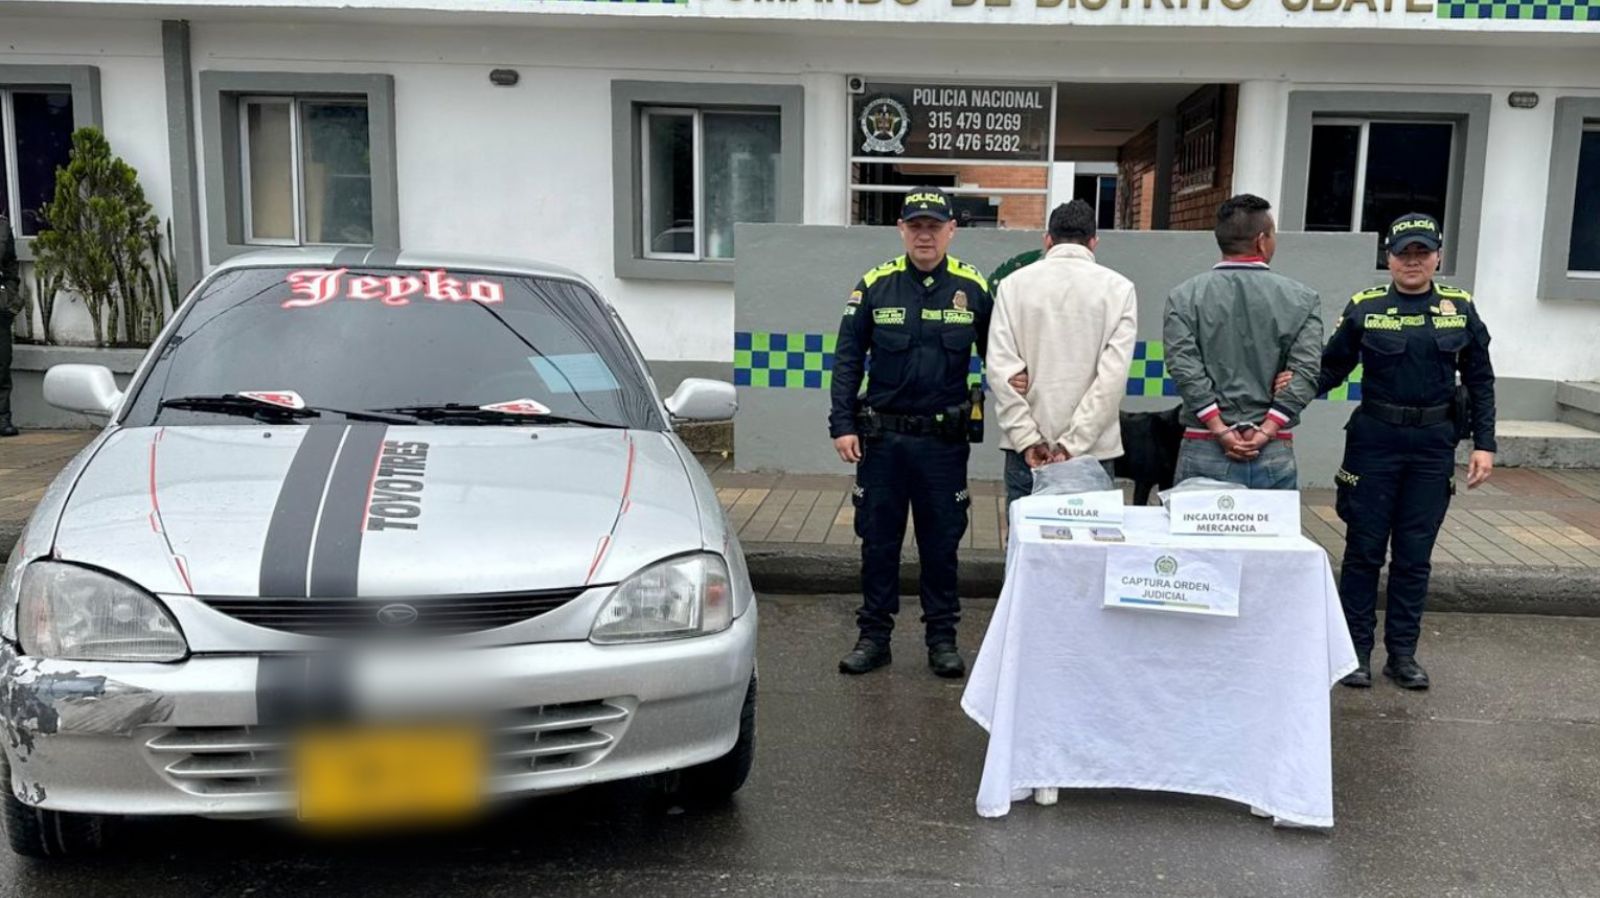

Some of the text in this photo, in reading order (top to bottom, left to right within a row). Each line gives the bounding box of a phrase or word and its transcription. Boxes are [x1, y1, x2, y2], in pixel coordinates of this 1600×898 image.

[913, 88, 1043, 109] POLICIA NACIONAL
[928, 111, 1021, 131] 315 479 0269
[928, 133, 1020, 152] 312 476 5282
[281, 267, 504, 308] Jeyko
[367, 441, 429, 531] TOYO TIRES
[1057, 507, 1099, 518] CELULAR
[1183, 513, 1269, 522] INCAUTACION DE
[1196, 523, 1257, 532] MERCANCIA
[1121, 576, 1210, 592] CAPTURA ORDEN
[1141, 589, 1188, 601] JUDICIAL
